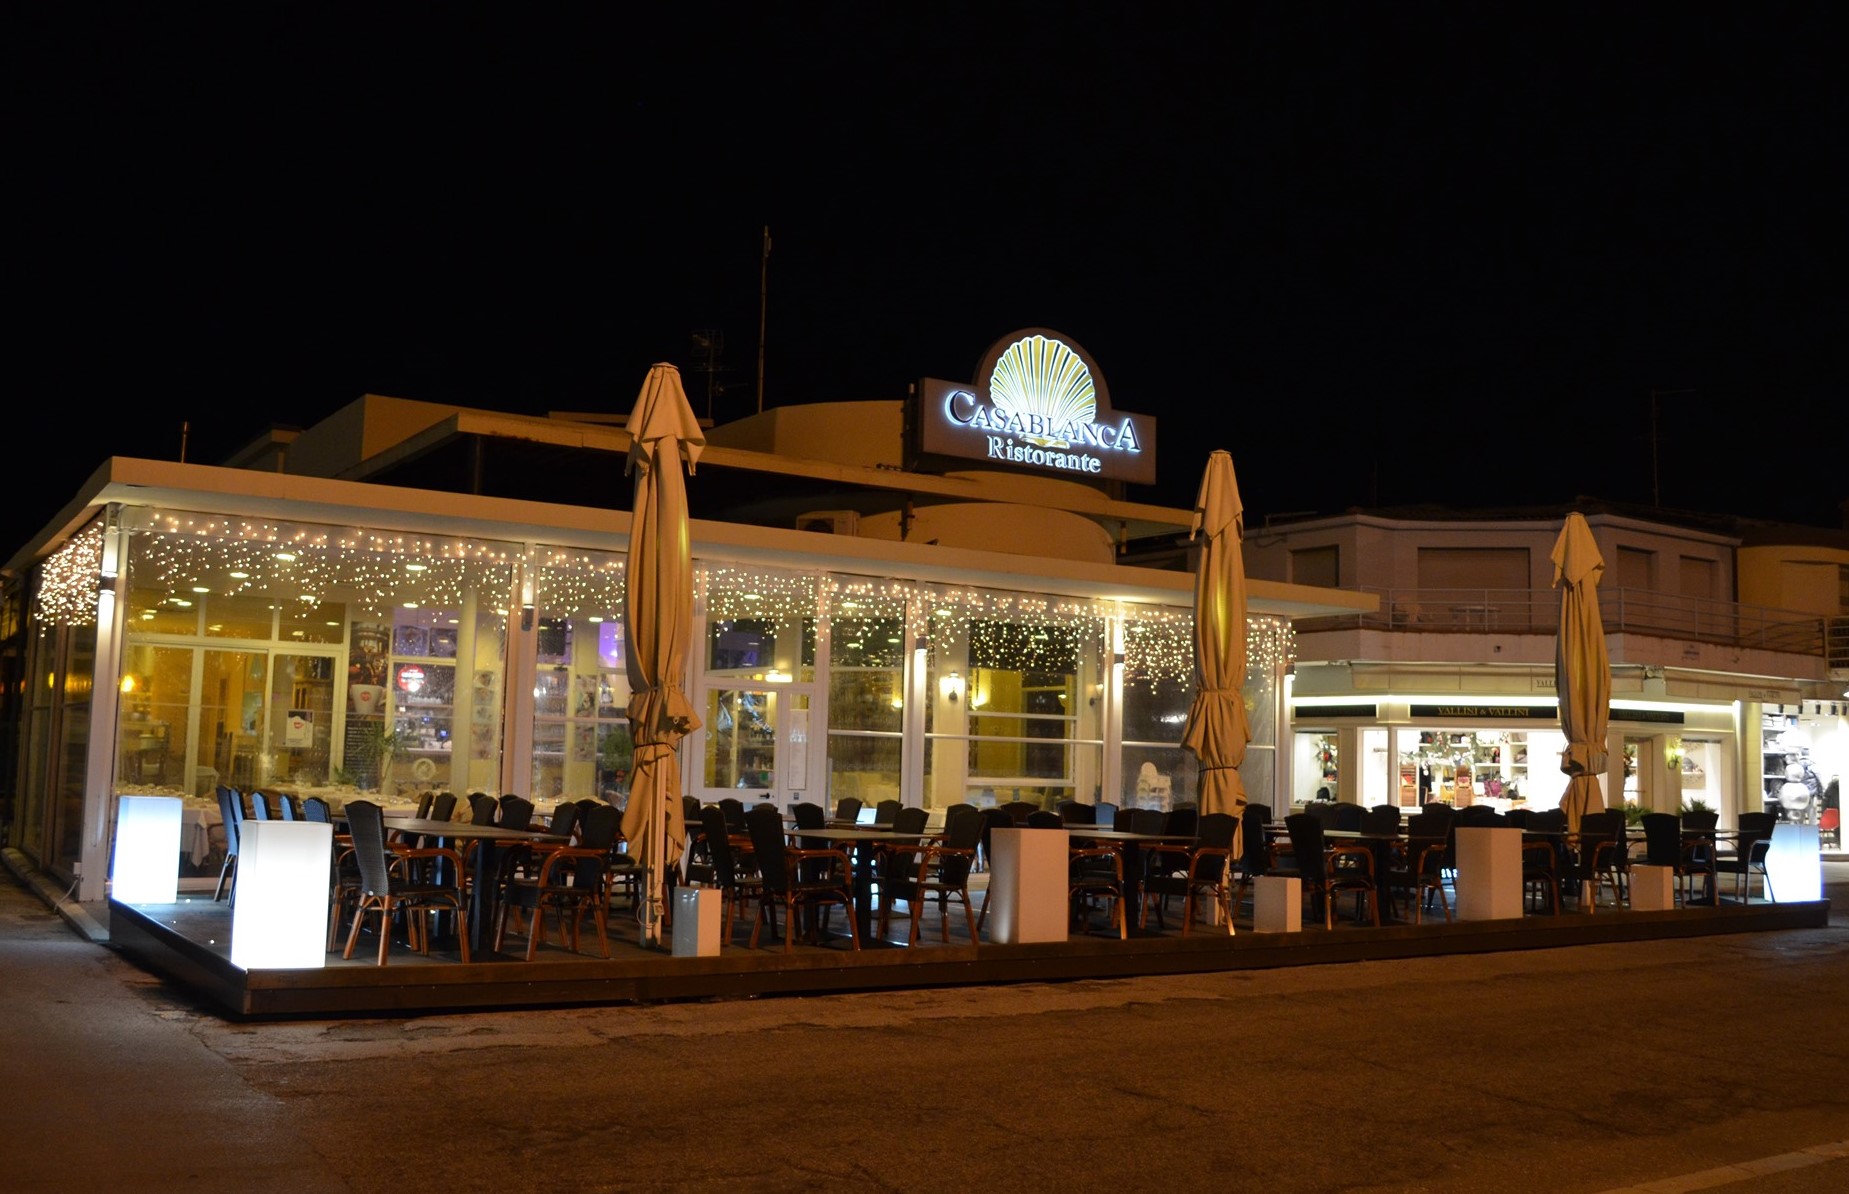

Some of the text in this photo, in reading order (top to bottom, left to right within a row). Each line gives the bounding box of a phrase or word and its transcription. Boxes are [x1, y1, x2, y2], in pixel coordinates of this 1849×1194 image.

[945, 390, 1141, 453] CASABLANCA
[987, 435, 1102, 474] Ristorante
[1438, 706, 1478, 716] VALLINI
[1488, 707, 1529, 717] VALLINI
